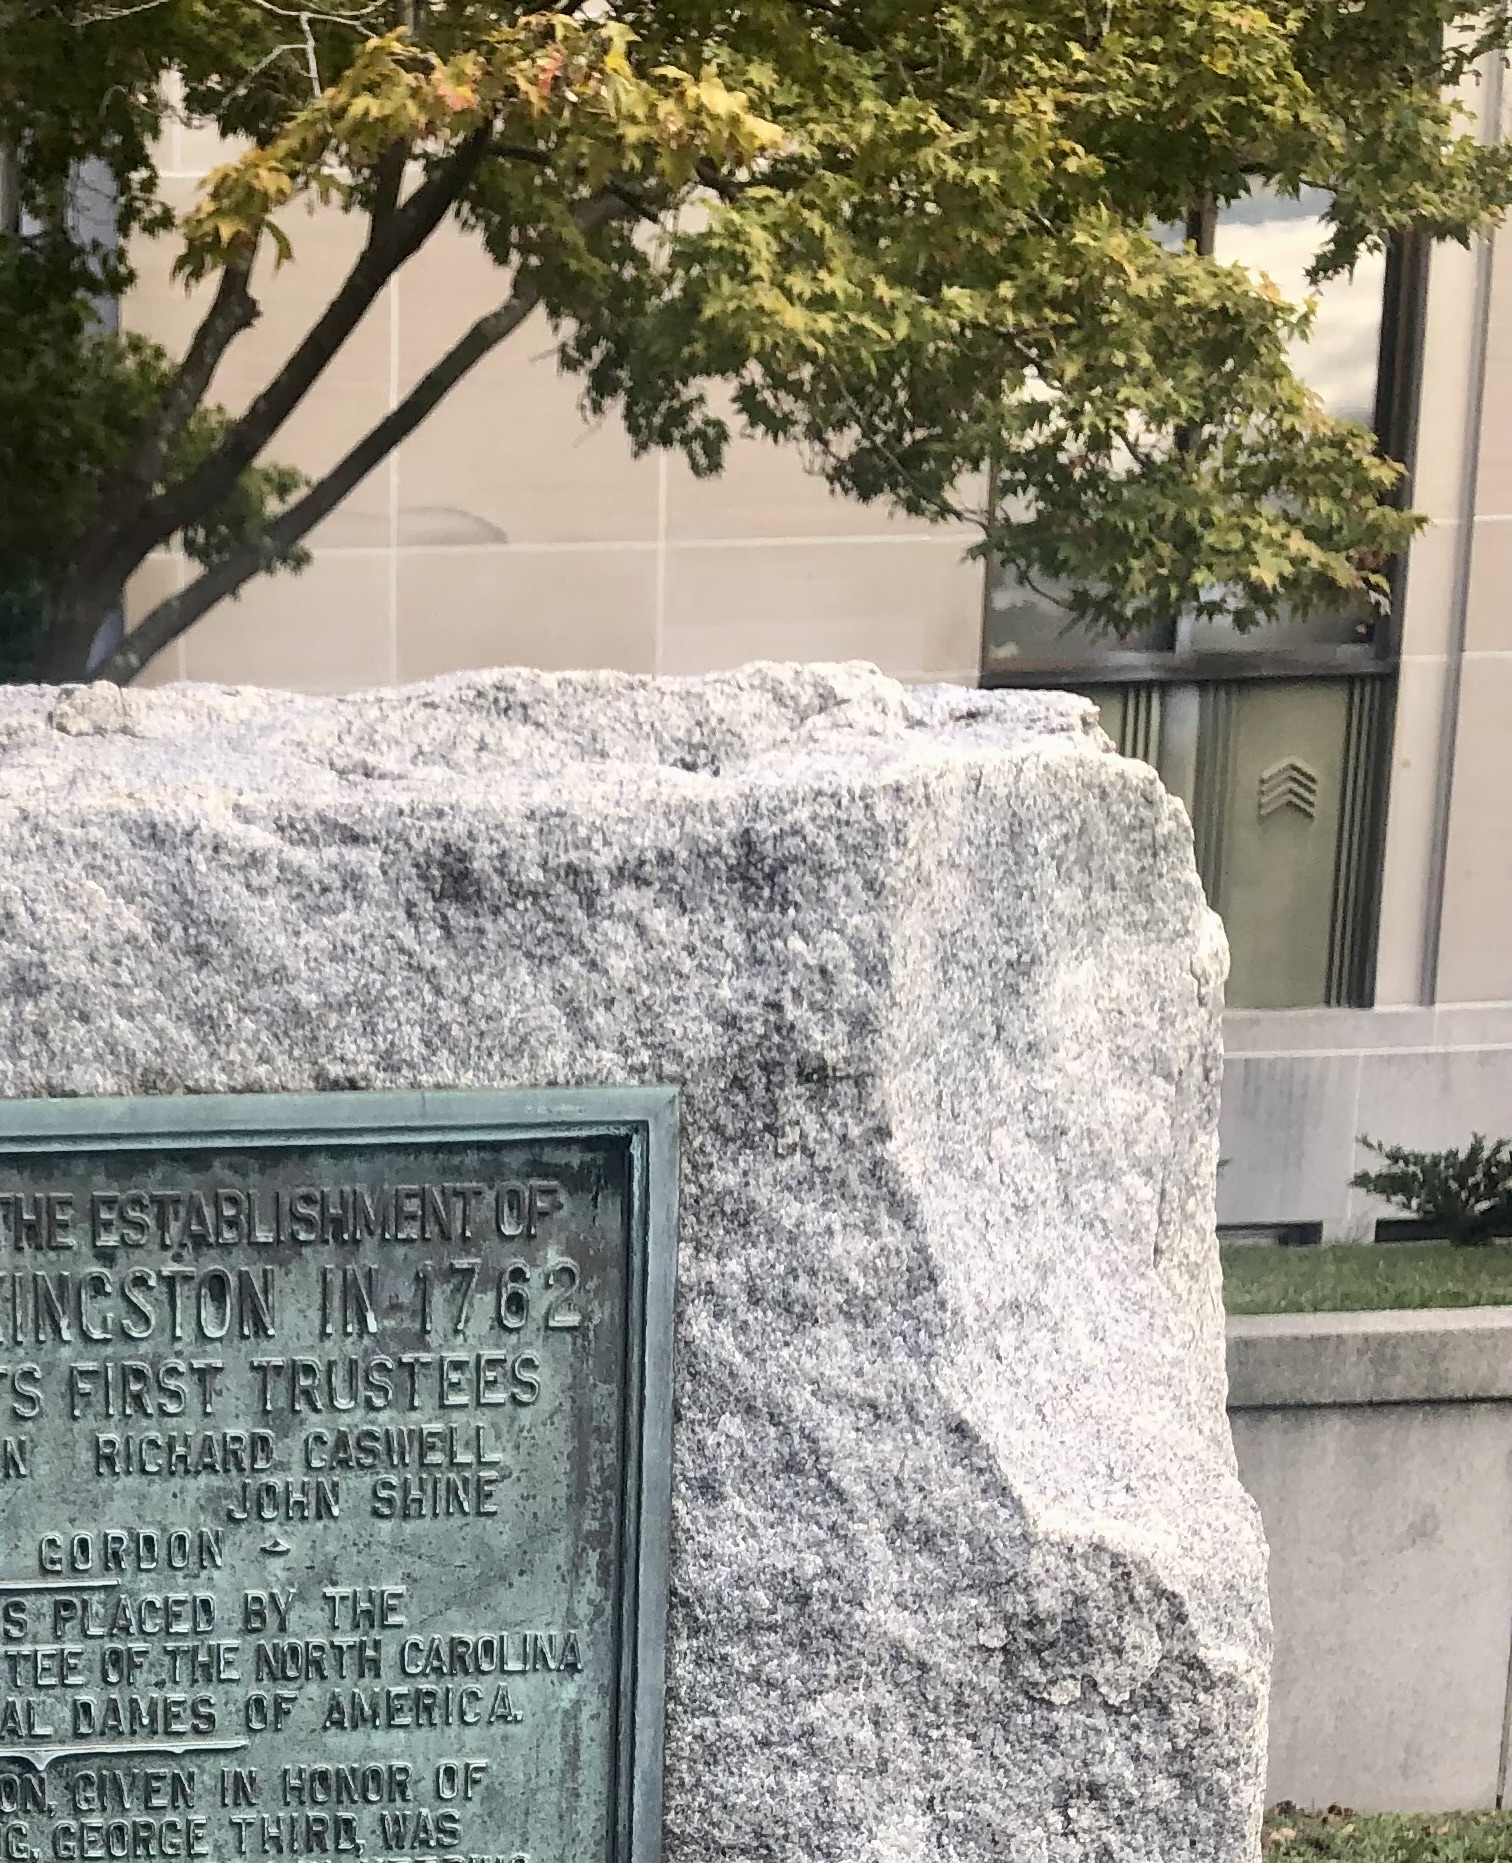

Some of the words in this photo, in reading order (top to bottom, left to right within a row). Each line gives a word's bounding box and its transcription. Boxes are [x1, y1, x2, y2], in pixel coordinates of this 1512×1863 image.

[92, 1183, 483, 1248] ESTABLISHMENT
[495, 1178, 563, 1239] OF
[321, 1262, 379, 1335] IN
[417, 1257, 581, 1333] 1762
[70, 1357, 225, 1419] FIRST
[251, 1349, 541, 1412] TRUSTEES
[95, 1429, 276, 1476] RICHARD
[304, 1423, 502, 1470] CASWELL
[227, 1476, 340, 1521] JOHN
[371, 1471, 500, 1518] SHINE
[40, 1528, 224, 1573] GORDON
[54, 1592, 216, 1638] PLACED
[244, 1588, 296, 1633] BY
[323, 1585, 407, 1629] THE
[101, 1644, 152, 1685] OF
[165, 1640, 241, 1684] THE
[256, 1636, 382, 1682] NORTH
[399, 1629, 583, 1677] CAROLINA
[73, 1694, 216, 1735] DAMES
[245, 1690, 298, 1732] OF
[325, 1685, 524, 1731] AMERICA.
[74, 1767, 195, 1811] GIVEN
[220, 1765, 257, 1807] IN
[284, 1761, 412, 1806] HONOR
[435, 1758, 490, 1801] OF
[51, 1815, 207, 1860] GEORGE
[229, 1811, 366, 1857] THIRD,
[379, 1808, 462, 1849] WAS
